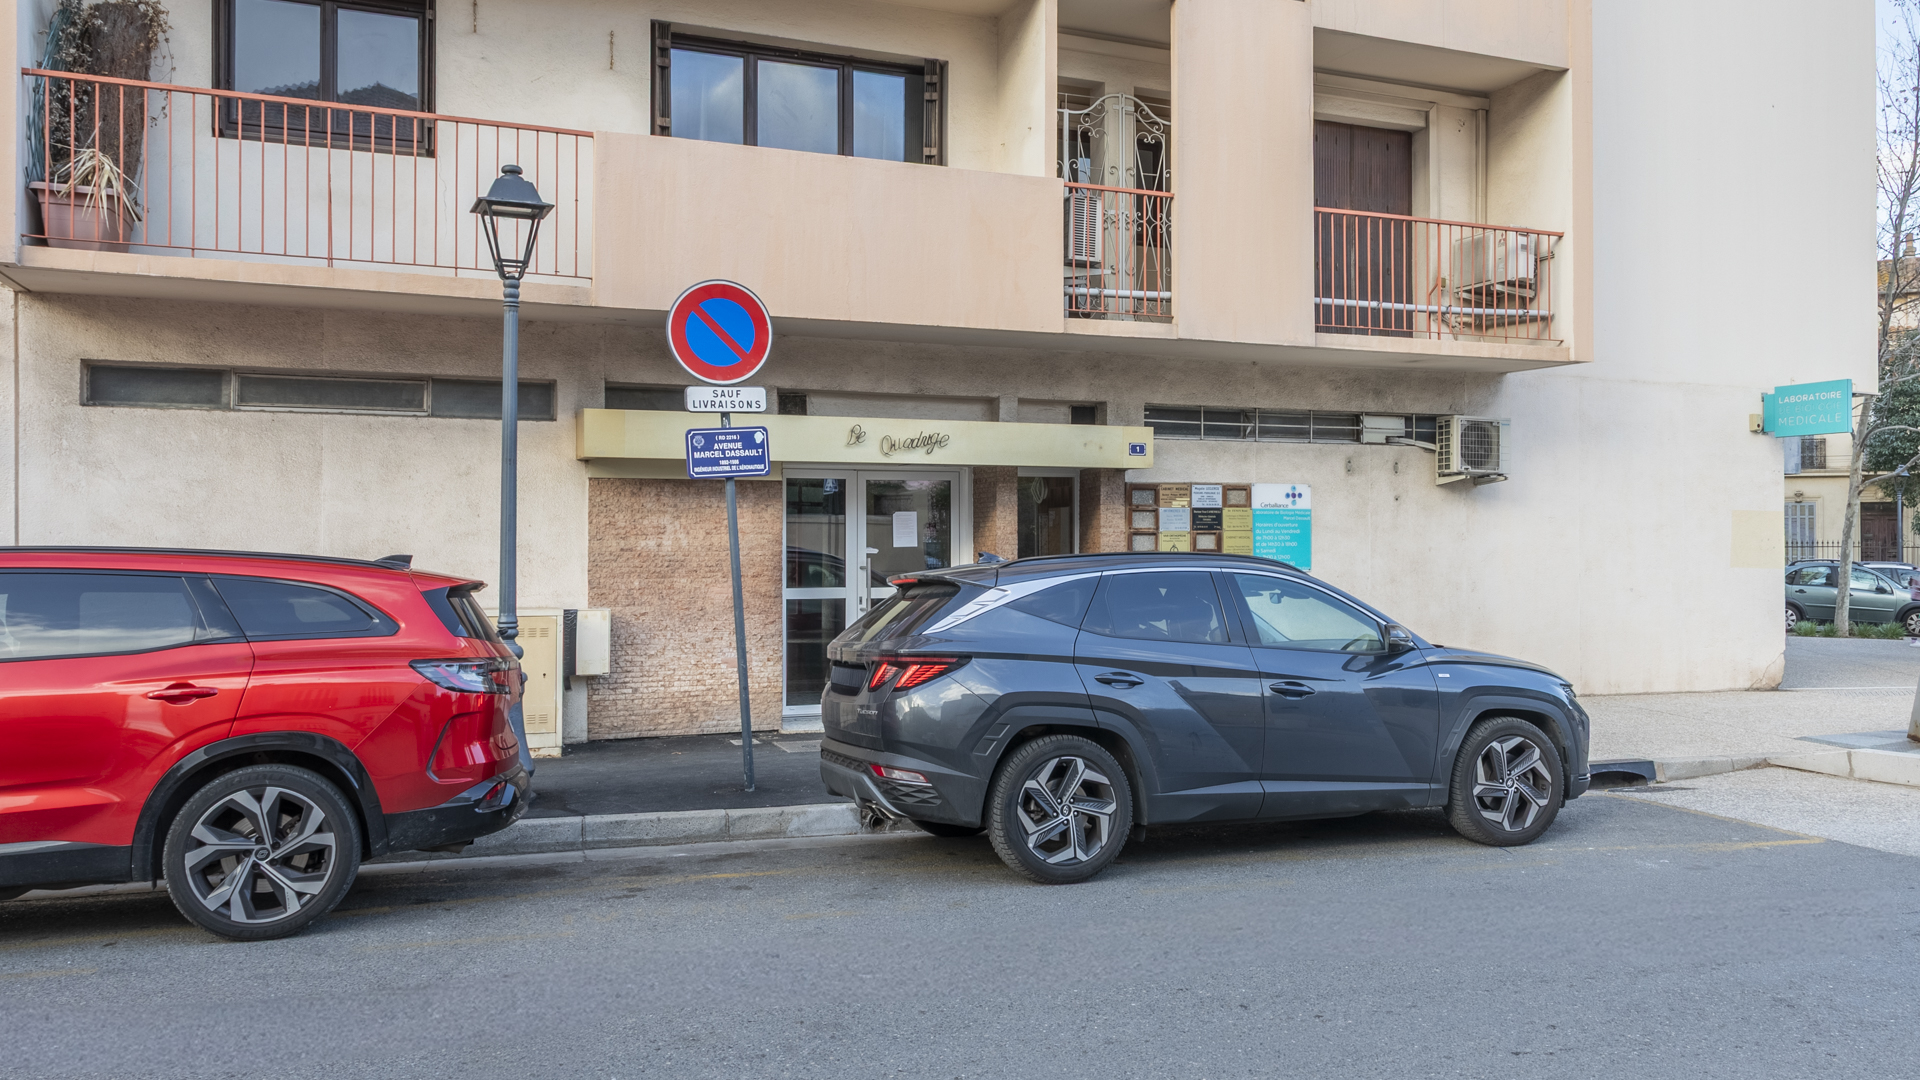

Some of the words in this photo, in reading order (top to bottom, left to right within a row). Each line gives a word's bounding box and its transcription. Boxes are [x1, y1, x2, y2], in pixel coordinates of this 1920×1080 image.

[712, 390, 741, 398] SAUF
[1778, 390, 1842, 404] LABORATOIRE
[692, 400, 761, 409] LIVRAISONS
[1778, 412, 1842, 426] MEDICALE
[846, 424, 866, 446] Le
[725, 449, 763, 457] DASSAULT
